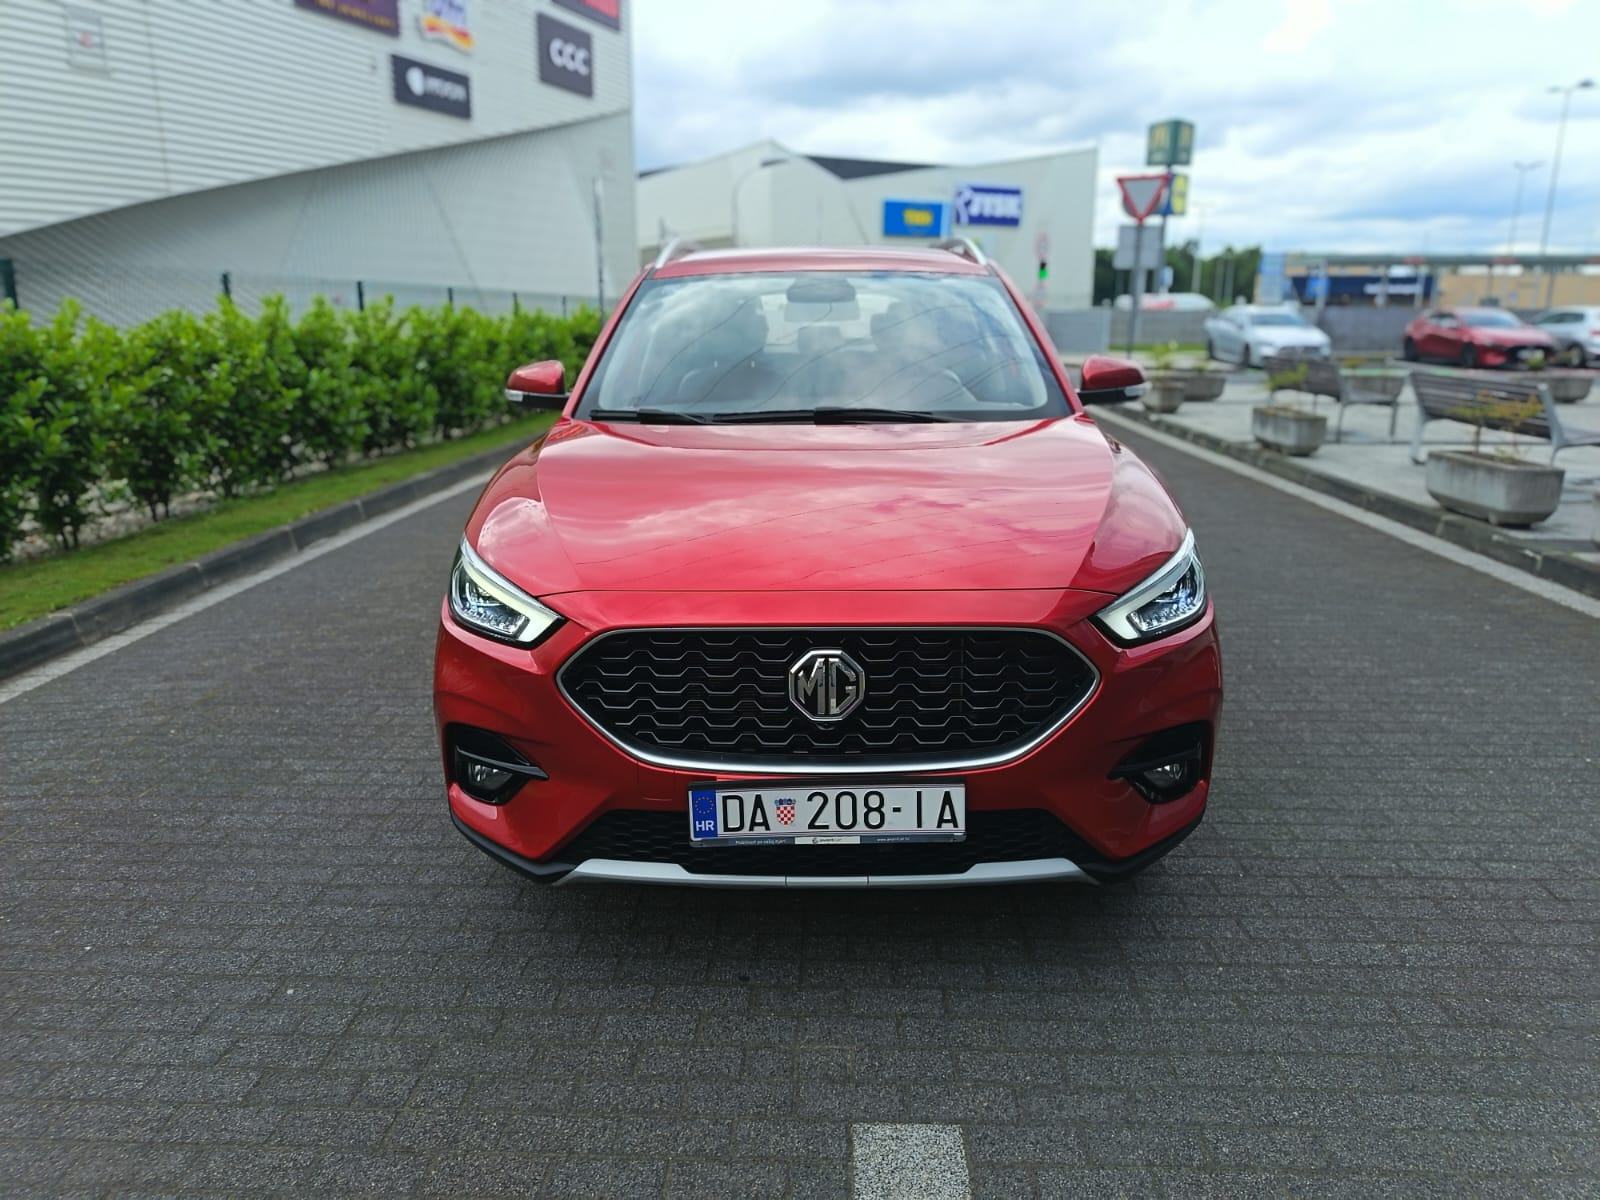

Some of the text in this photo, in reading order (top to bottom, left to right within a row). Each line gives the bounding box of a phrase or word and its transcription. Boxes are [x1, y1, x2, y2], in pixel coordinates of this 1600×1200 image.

[549, 38, 589, 76] CCC
[798, 657, 857, 715] MG
[695, 820, 715, 832] HR
[721, 794, 771, 832] DA
